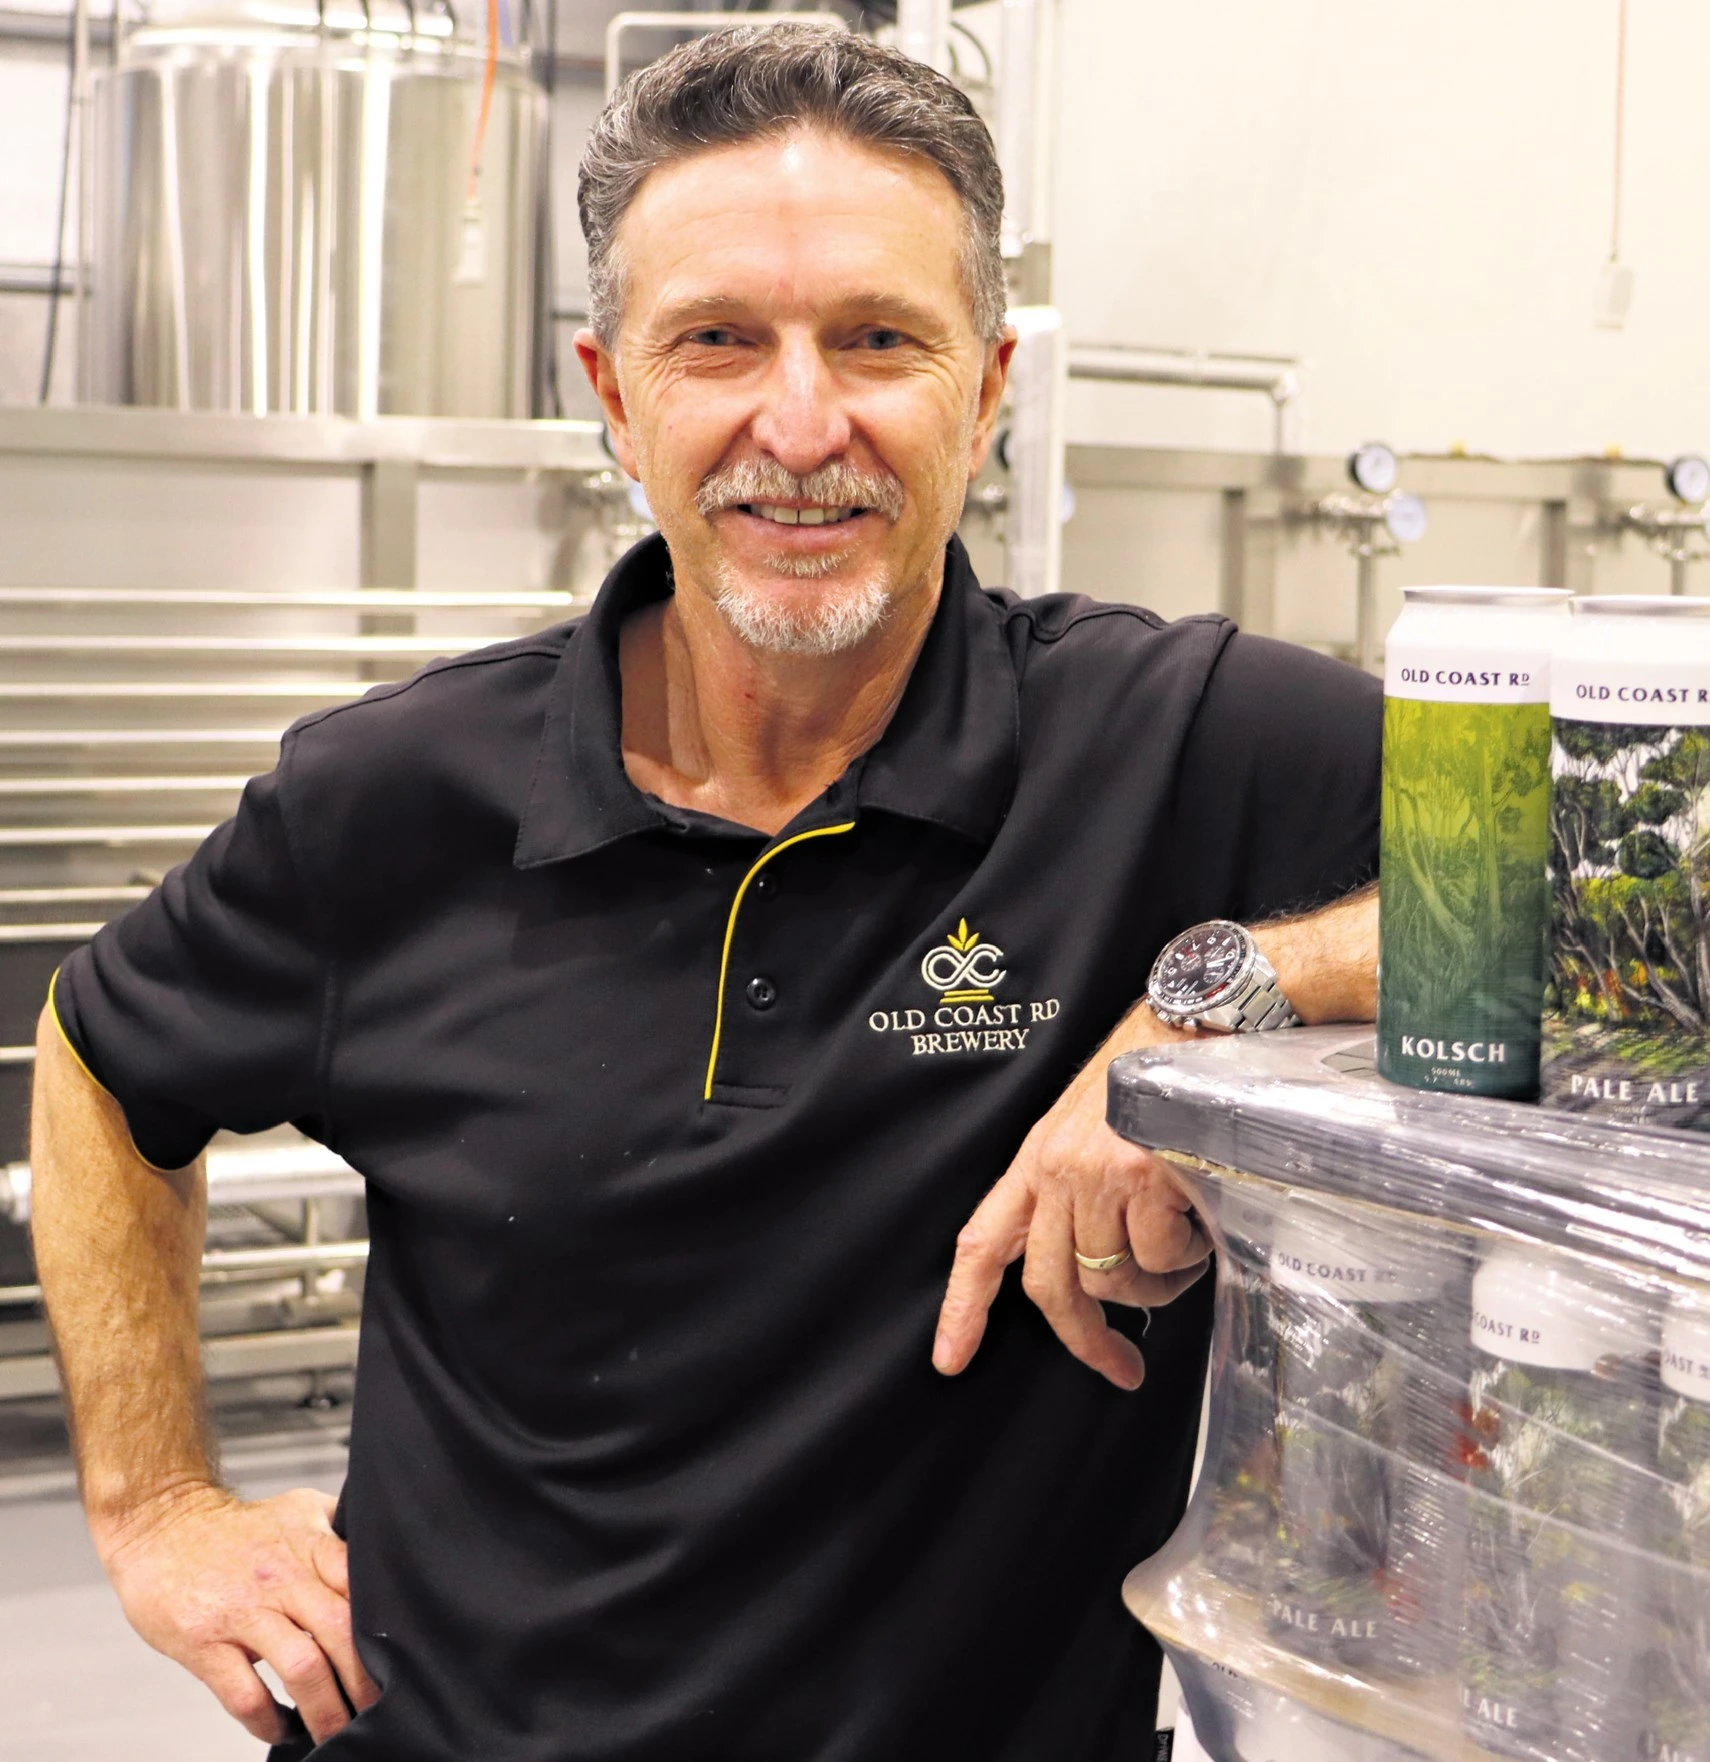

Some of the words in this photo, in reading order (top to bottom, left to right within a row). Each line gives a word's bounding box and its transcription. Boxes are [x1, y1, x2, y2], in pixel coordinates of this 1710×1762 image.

[1401, 668, 1429, 683] OLD
[1436, 670, 1501, 686] COAST
[1576, 684, 1610, 700] OLD
[1617, 686, 1689, 703] COAST
[869, 1009, 925, 1032] OLD
[934, 1004, 1021, 1028] COAST
[1030, 998, 1060, 1022] RD
[910, 1028, 1030, 1055] BREWERY
[1401, 1035, 1505, 1063] KOLSCH
[1571, 1075, 1632, 1101] PALE
[1647, 1083, 1699, 1104] ALE
[1306, 1262, 1367, 1282] COAST
[1271, 1600, 1318, 1632] PALE
[1331, 1618, 1379, 1638] ALE
[1477, 1697, 1518, 1728] ALE
